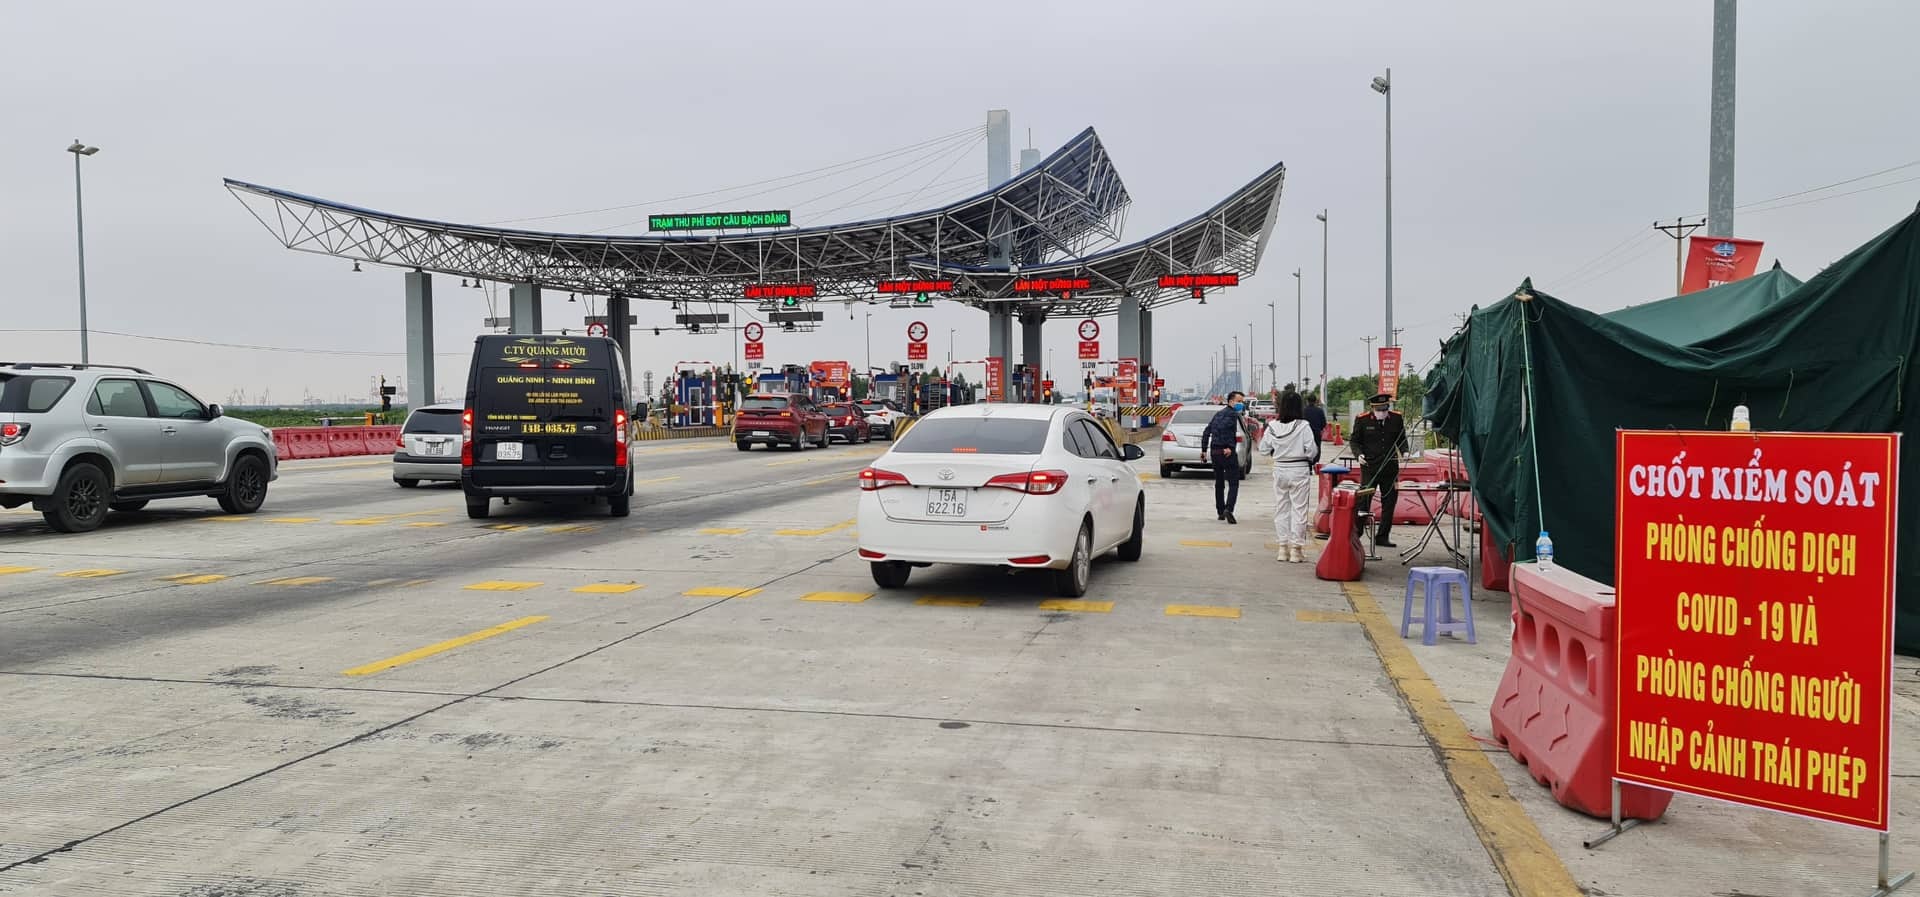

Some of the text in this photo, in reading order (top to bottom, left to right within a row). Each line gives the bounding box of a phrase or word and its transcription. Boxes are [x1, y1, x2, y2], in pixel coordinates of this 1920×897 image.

[651, 213, 788, 229] TRẠM THU PHÍ BOT CẦU BẠCH ĐẰNG
[504, 344, 586, 356] C.TY QUANG MƯỜI
[1082, 361, 1096, 369] SLOW
[526, 376, 545, 384] NINH
[552, 376, 573, 385] NINH
[575, 376, 595, 385] BÌNH
[545, 424, 577, 433] 035.75
[1629, 448, 1880, 507] CHỐT KIỂM SOÁT
[939, 490, 957, 501] 15A
[928, 503, 964, 514] 622.16
[1646, 514, 1856, 583] PHÒNG CHỐNG DỊCH
[1677, 592, 1738, 636] COVID
[1759, 601, 1784, 642] 19
[1790, 596, 1819, 645] VÀ
[1637, 649, 1861, 725] PHÒNG CHỐNG NGƯỜI
[1630, 717, 1867, 799] NHẬP CẢNH TRÁI PHÉP
